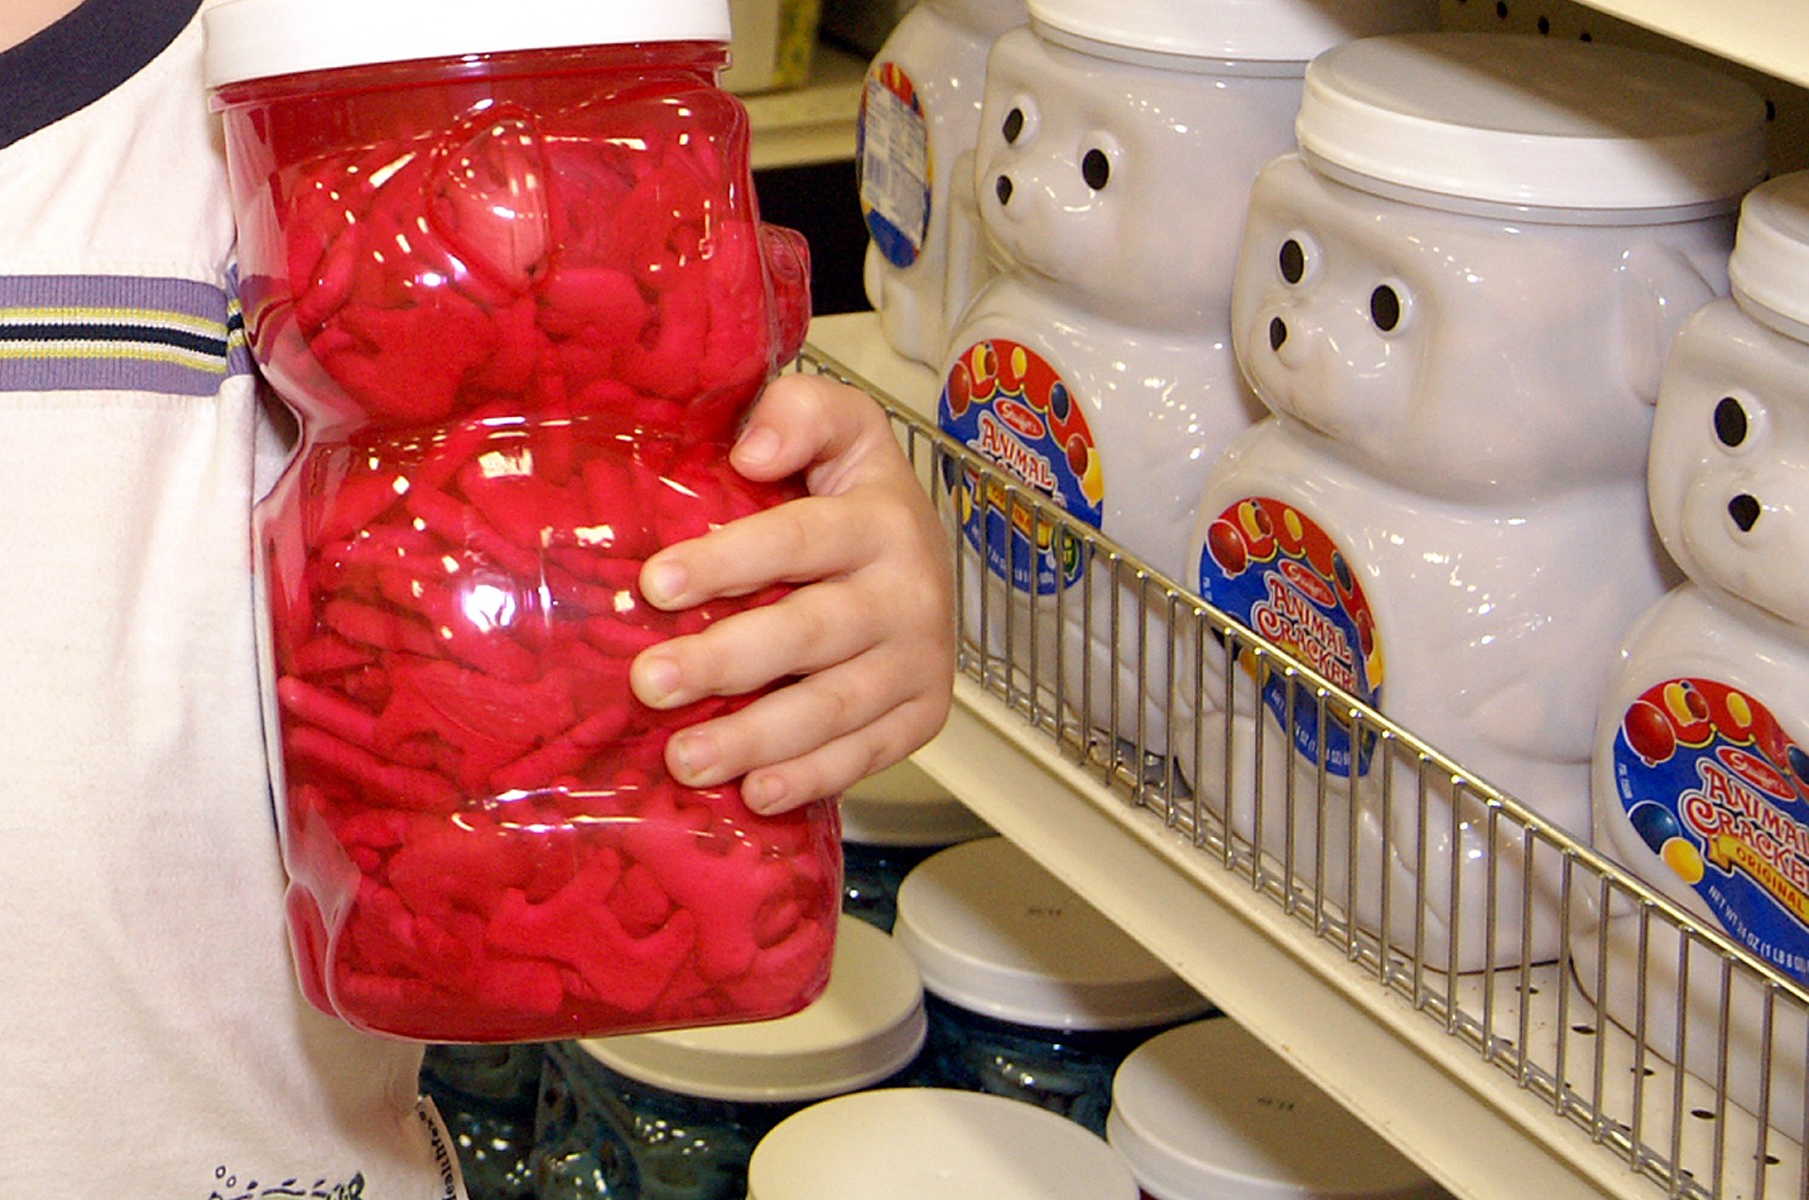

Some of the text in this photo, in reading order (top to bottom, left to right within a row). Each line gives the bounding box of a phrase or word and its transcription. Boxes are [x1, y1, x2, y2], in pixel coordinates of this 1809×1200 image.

[981, 416, 1054, 488] ANIMAL
[1269, 576, 1352, 662] ANIMAL
[1685, 798, 1809, 889] CRACKE
[1736, 846, 1806, 915] ORIGINAL
